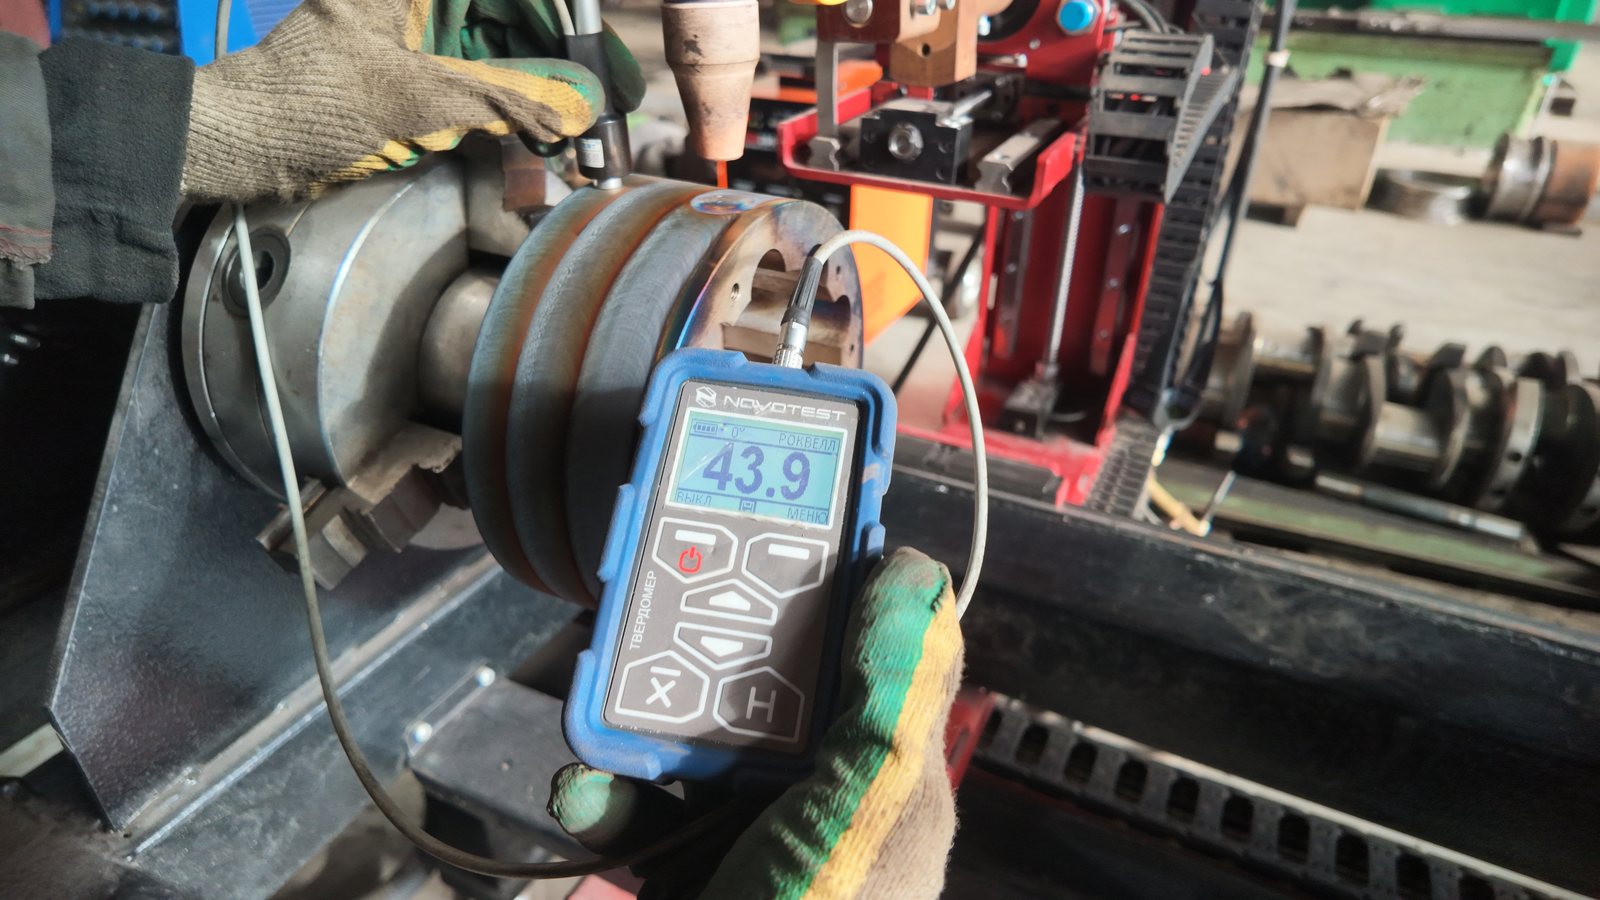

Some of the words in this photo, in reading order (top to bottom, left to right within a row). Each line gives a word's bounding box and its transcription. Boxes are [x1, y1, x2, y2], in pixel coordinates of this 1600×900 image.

[723, 395, 846, 421] NOVOTEST
[778, 432, 837, 450] РОКВЕЛЛ
[702, 442, 811, 501] 43.9
[675, 491, 712, 505] ВЫКЛ
[787, 506, 828, 523] МЕНЮ
[629, 570, 657, 651] ТВЕРДОМЕР
